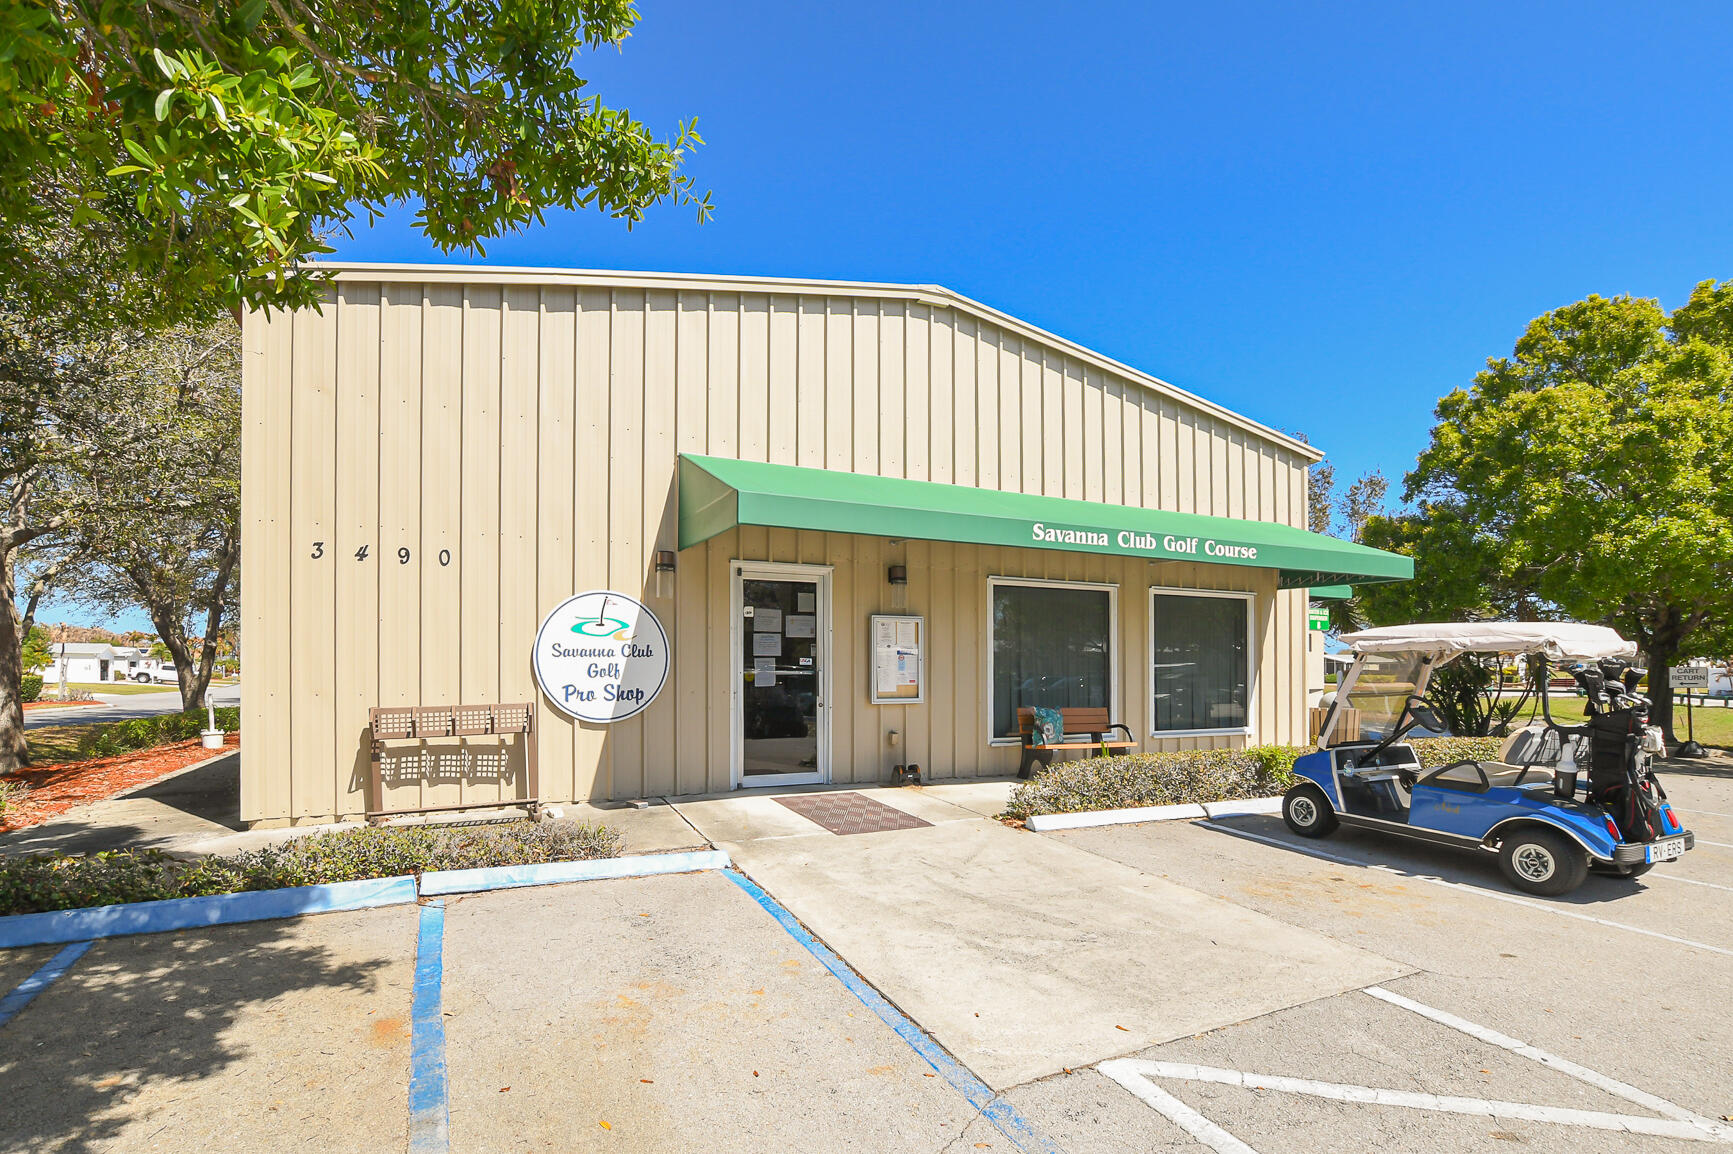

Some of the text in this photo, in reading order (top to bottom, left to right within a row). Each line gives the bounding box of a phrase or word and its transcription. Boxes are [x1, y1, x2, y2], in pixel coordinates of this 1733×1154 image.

[1032, 523, 1257, 559] Savanna Club Golf Course
[552, 643, 654, 658] Savanna Club
[587, 663, 621, 679] Golf
[562, 683, 645, 706] Pro Shop
